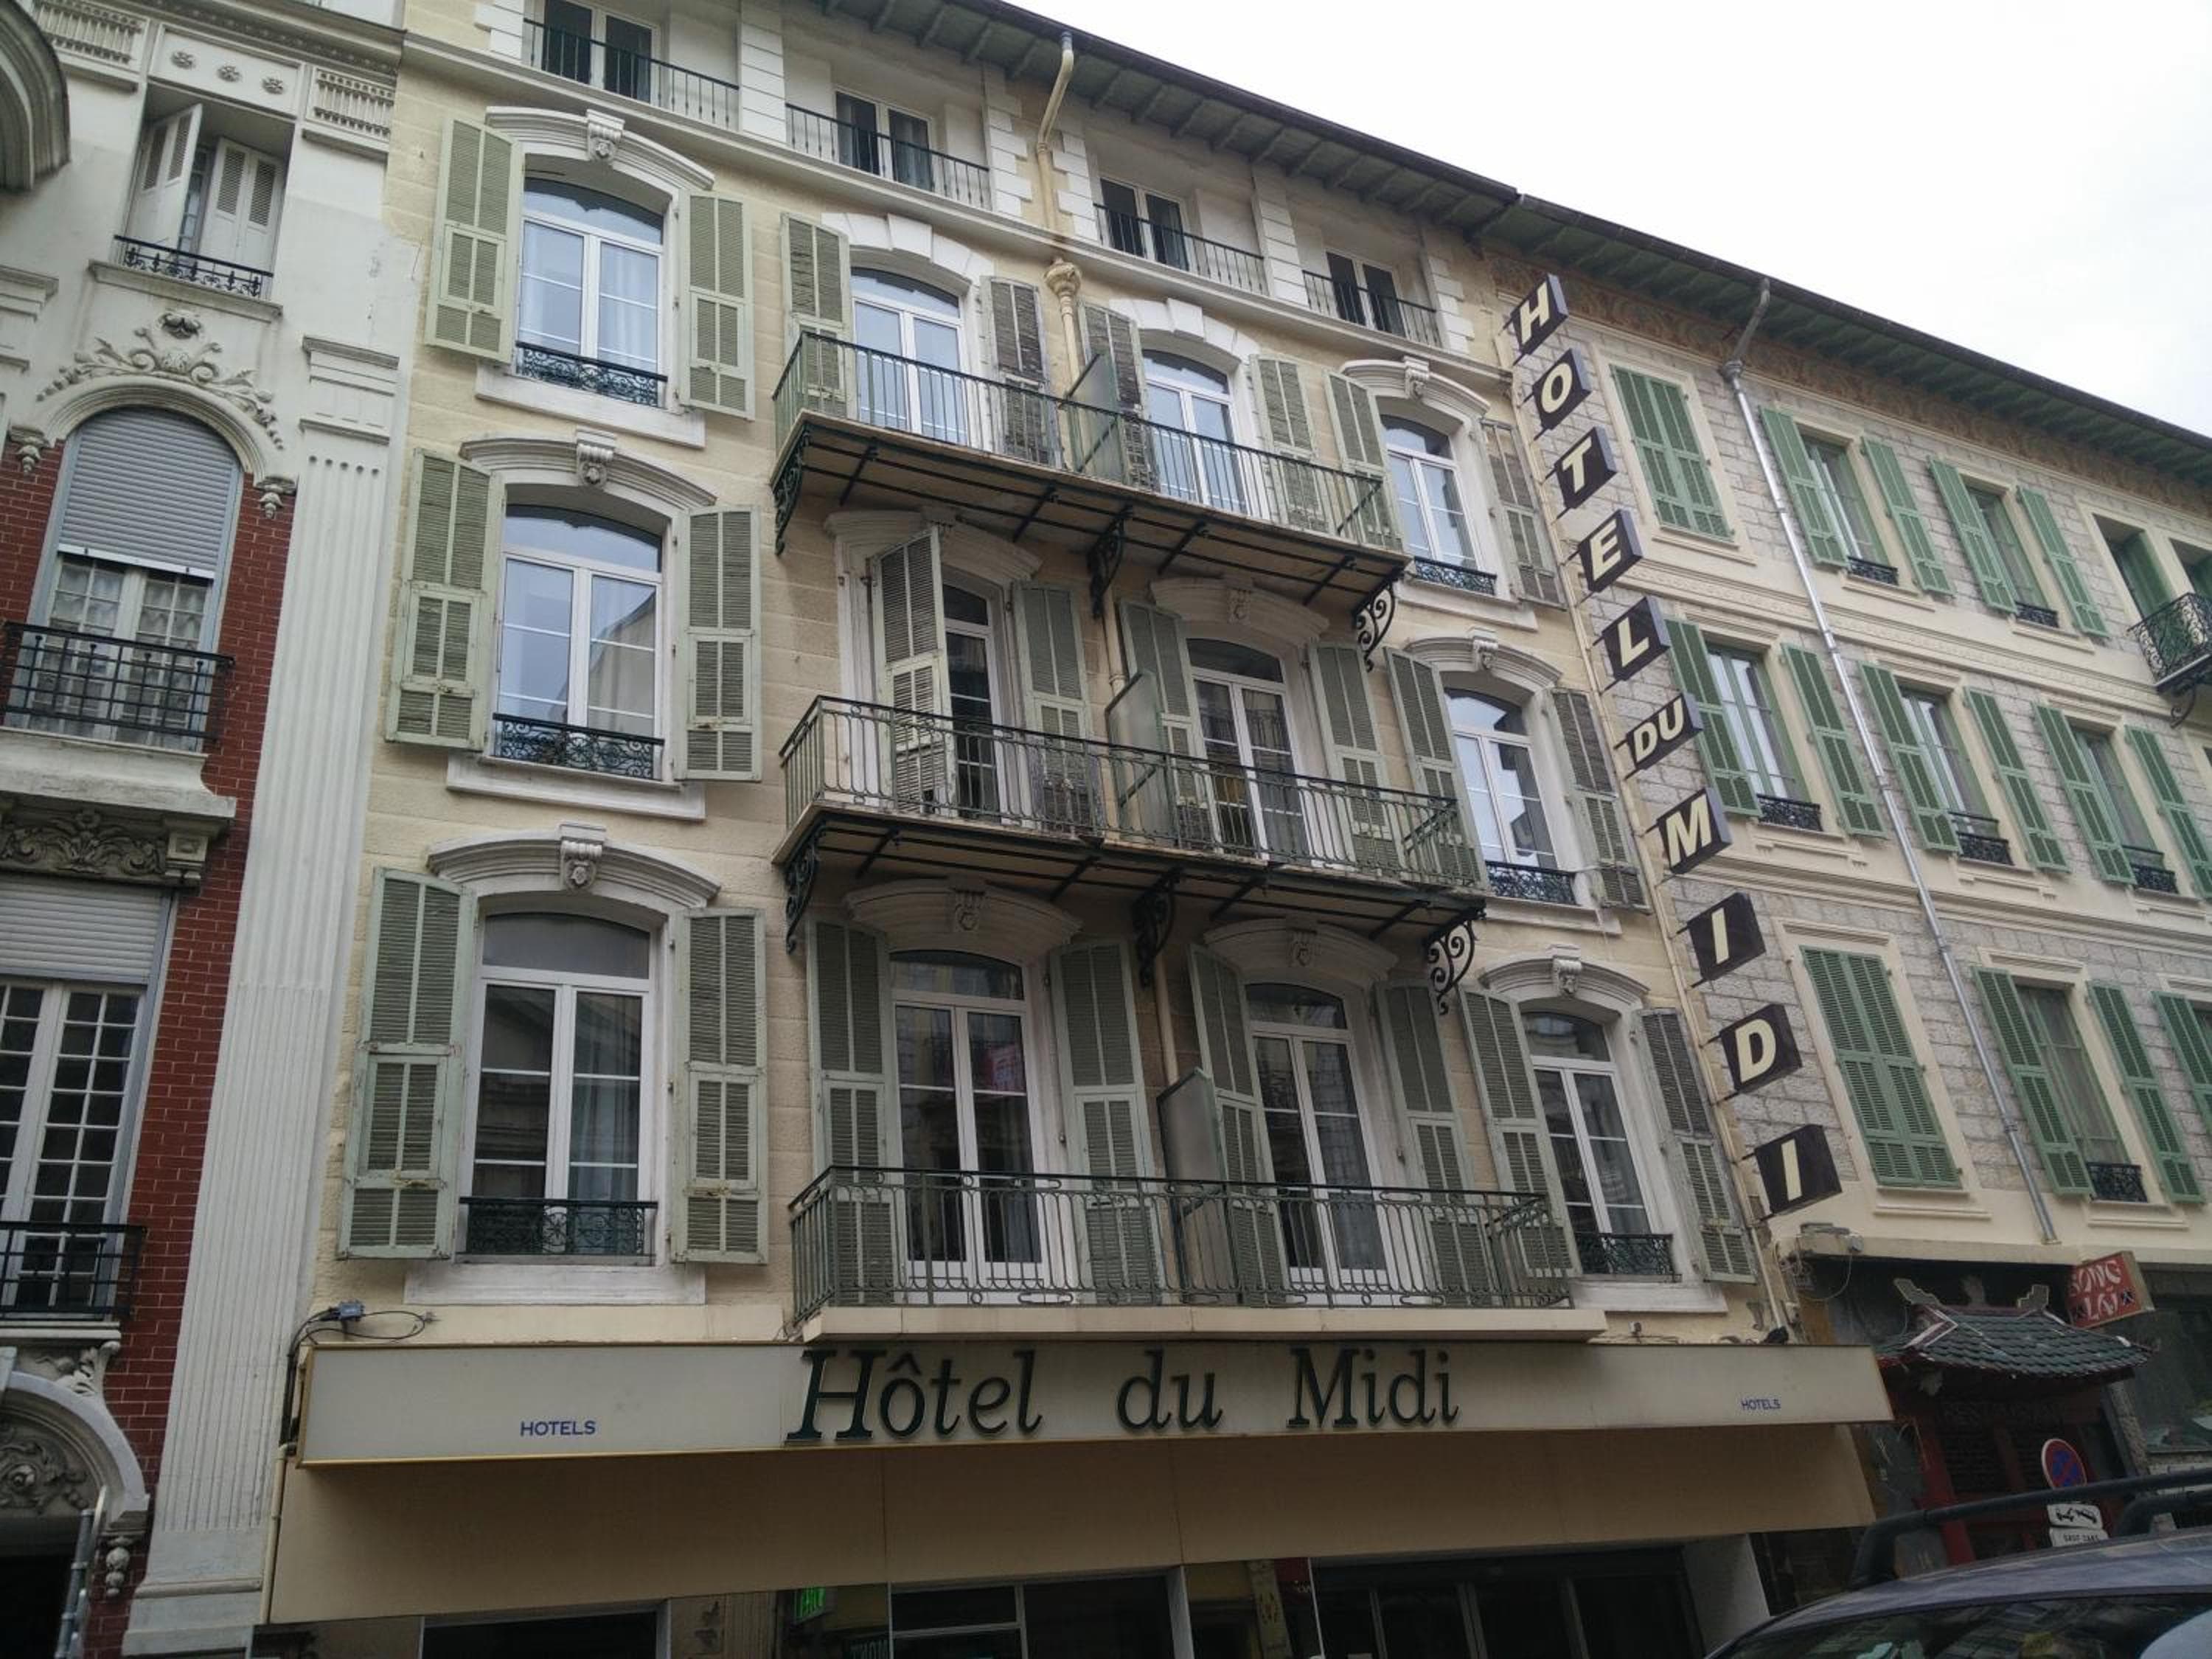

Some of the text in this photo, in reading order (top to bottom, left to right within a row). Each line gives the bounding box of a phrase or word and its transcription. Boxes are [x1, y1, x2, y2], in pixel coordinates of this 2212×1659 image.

[1632, 698, 1686, 759] DU
[786, 1347, 1460, 1443] Hôtel du Midi
[1741, 1398, 1781, 1411] HOTELS
[520, 1420, 597, 1437] HOTELS
